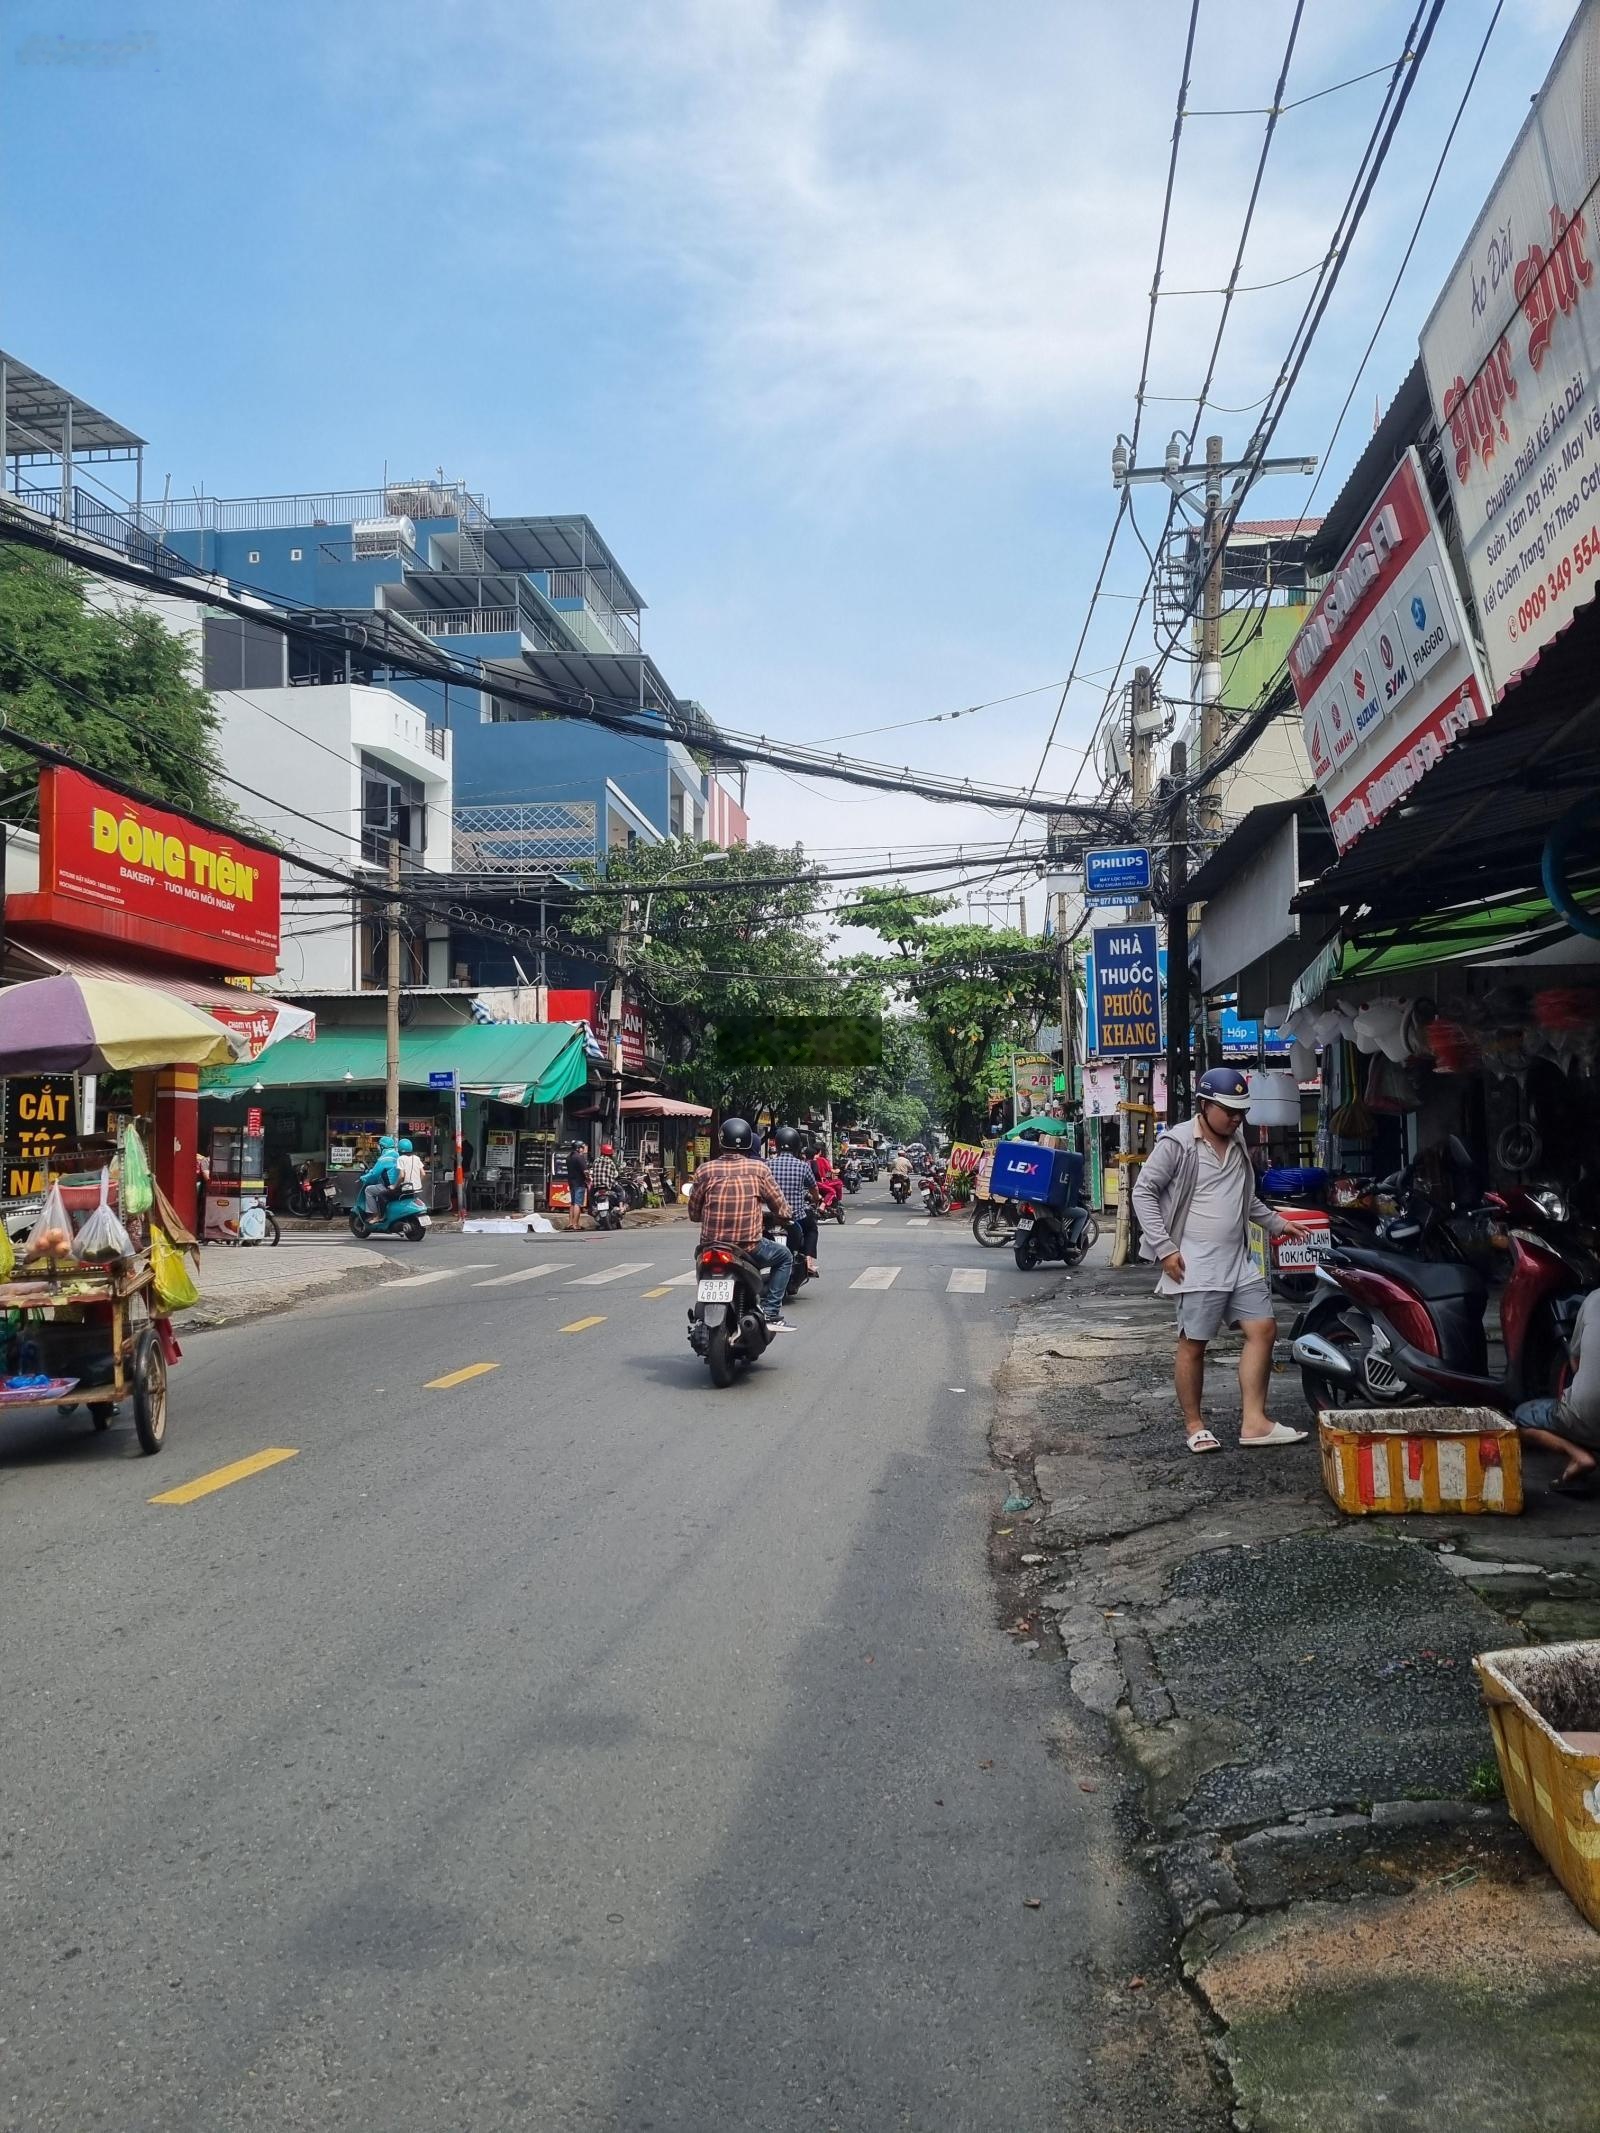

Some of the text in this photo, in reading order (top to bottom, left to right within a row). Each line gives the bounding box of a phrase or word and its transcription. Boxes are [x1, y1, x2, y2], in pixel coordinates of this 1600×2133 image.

[1485, 472, 1516, 521] Chuyên
[1515, 435, 1537, 481] Thiết
[1551, 402, 1565, 434] Áo
[1506, 507, 1527, 539] Xám
[1526, 489, 1541, 514] Dạ
[1540, 462, 1558, 498] Hội
[1562, 431, 1585, 471] May
[1483, 584, 1497, 616] Kết
[1519, 533, 1546, 572] Trang
[1555, 492, 1580, 526] Theo
[1517, 525, 1600, 633] 0909 349 554
[1412, 626, 1444, 668] PIAGGIO
[1385, 664, 1408, 700] SYM
[1356, 697, 1380, 731] SUZUKI
[1333, 729, 1354, 758] YAMAHA
[1315, 755, 1331, 780] HONDA
[92, 803, 254, 902] ĐỒNG TIỀN
[1092, 856, 1144, 869] PHILIPS
[120, 866, 156, 886] BAKERY
[1109, 933, 1142, 955] NHÀ
[1100, 960, 1154, 985] THUỐC
[1103, 987, 1153, 1017] PHƯỚC
[1102, 1022, 1156, 1047] KHANG
[20, 1084, 70, 1121] CẮT
[1007, 1160, 1039, 1175] LEX
[10, 1170, 60, 1196] NA
[701, 1291, 730, 1301] 480.59
[704, 1281, 729, 1291] 59-P3
